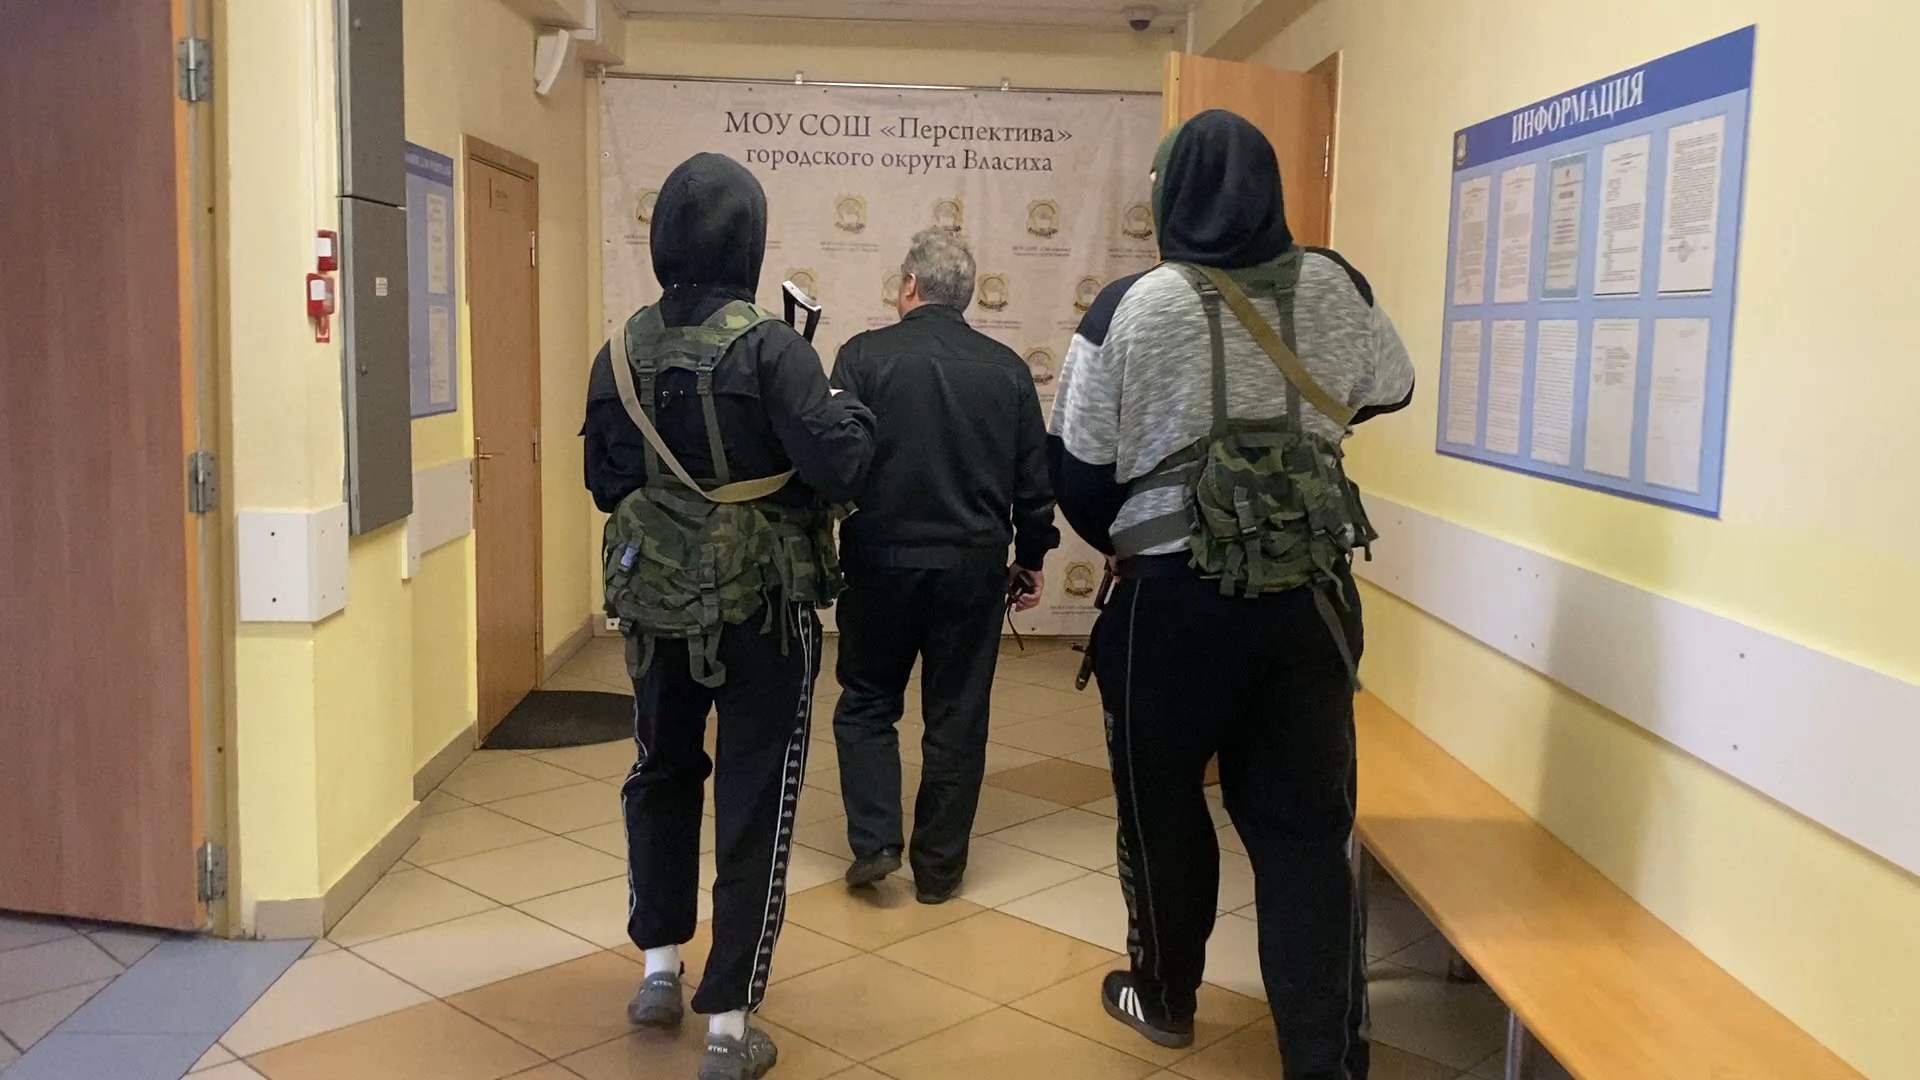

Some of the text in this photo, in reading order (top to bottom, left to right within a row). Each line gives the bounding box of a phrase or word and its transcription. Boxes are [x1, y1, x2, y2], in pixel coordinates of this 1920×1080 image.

[1511, 70, 1645, 144] ИНФОРМАЦИЯ
[724, 111, 1073, 148] МОУ СОШ «Перспектива»
[746, 149, 1053, 175] городского округа Власиха
